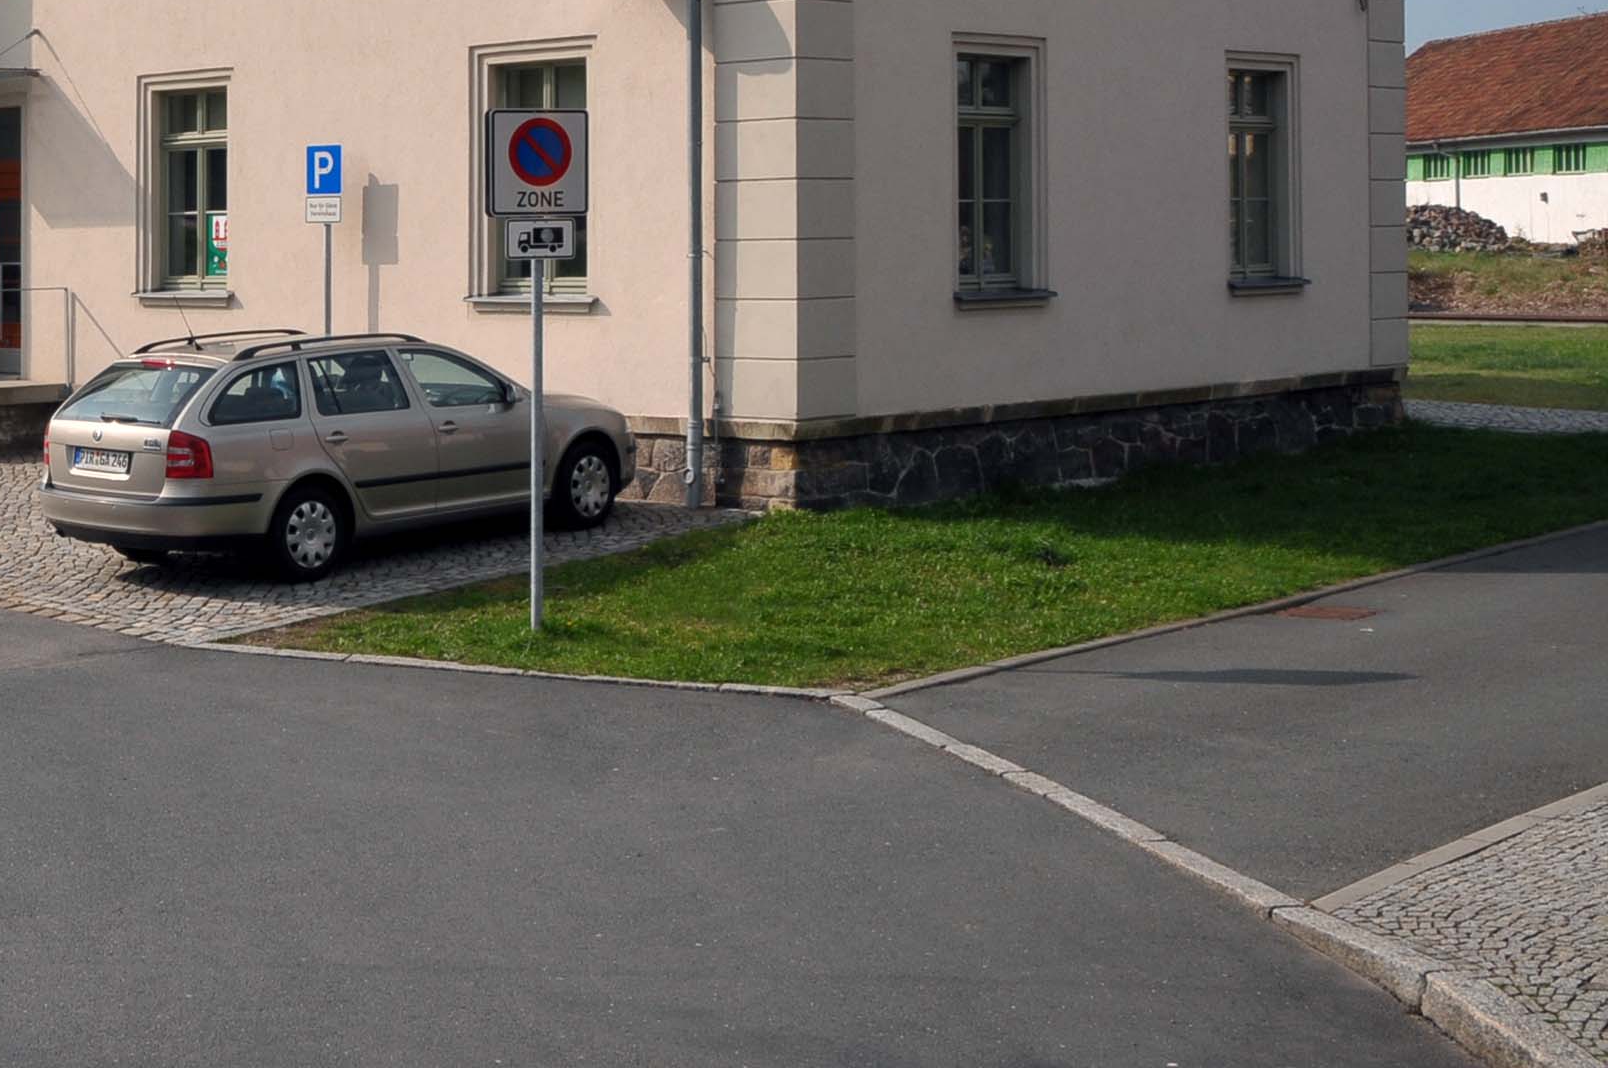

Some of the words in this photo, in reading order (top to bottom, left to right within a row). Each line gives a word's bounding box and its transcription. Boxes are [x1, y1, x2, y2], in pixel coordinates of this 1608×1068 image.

[314, 151, 334, 189] P
[517, 191, 565, 208] ZONE
[80, 449, 94, 464] PIR
